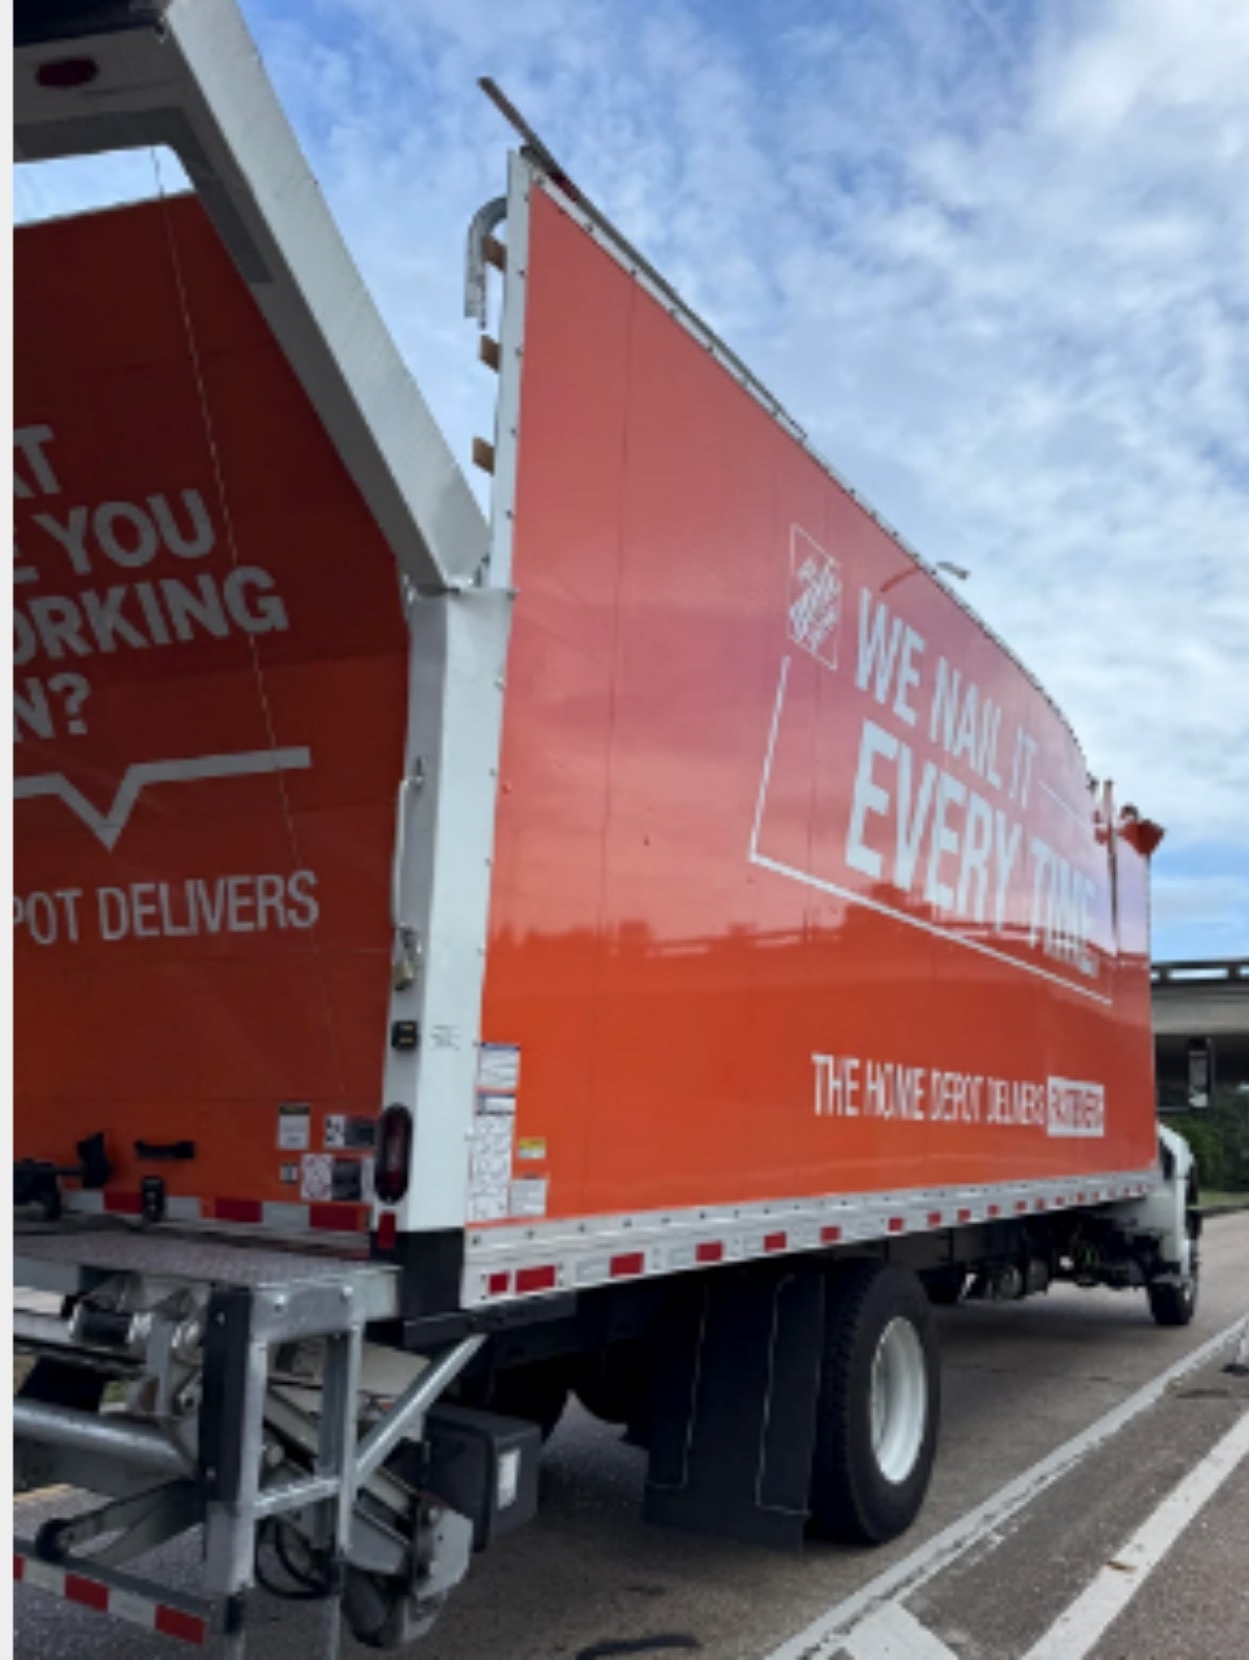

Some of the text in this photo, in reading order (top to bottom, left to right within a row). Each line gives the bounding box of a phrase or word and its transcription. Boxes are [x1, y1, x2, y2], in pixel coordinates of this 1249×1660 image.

[33, 489, 215, 575] YOU
[855, 586, 925, 726] WE
[929, 655, 1003, 788] NAIL
[1008, 724, 1038, 809] IT
[845, 719, 1023, 934] EVERY
[97, 870, 319, 941] DELIVERS
[811, 1053, 860, 1117] THE
[863, 1058, 925, 1121] HOME
[929, 1067, 983, 1124] DEPOT
